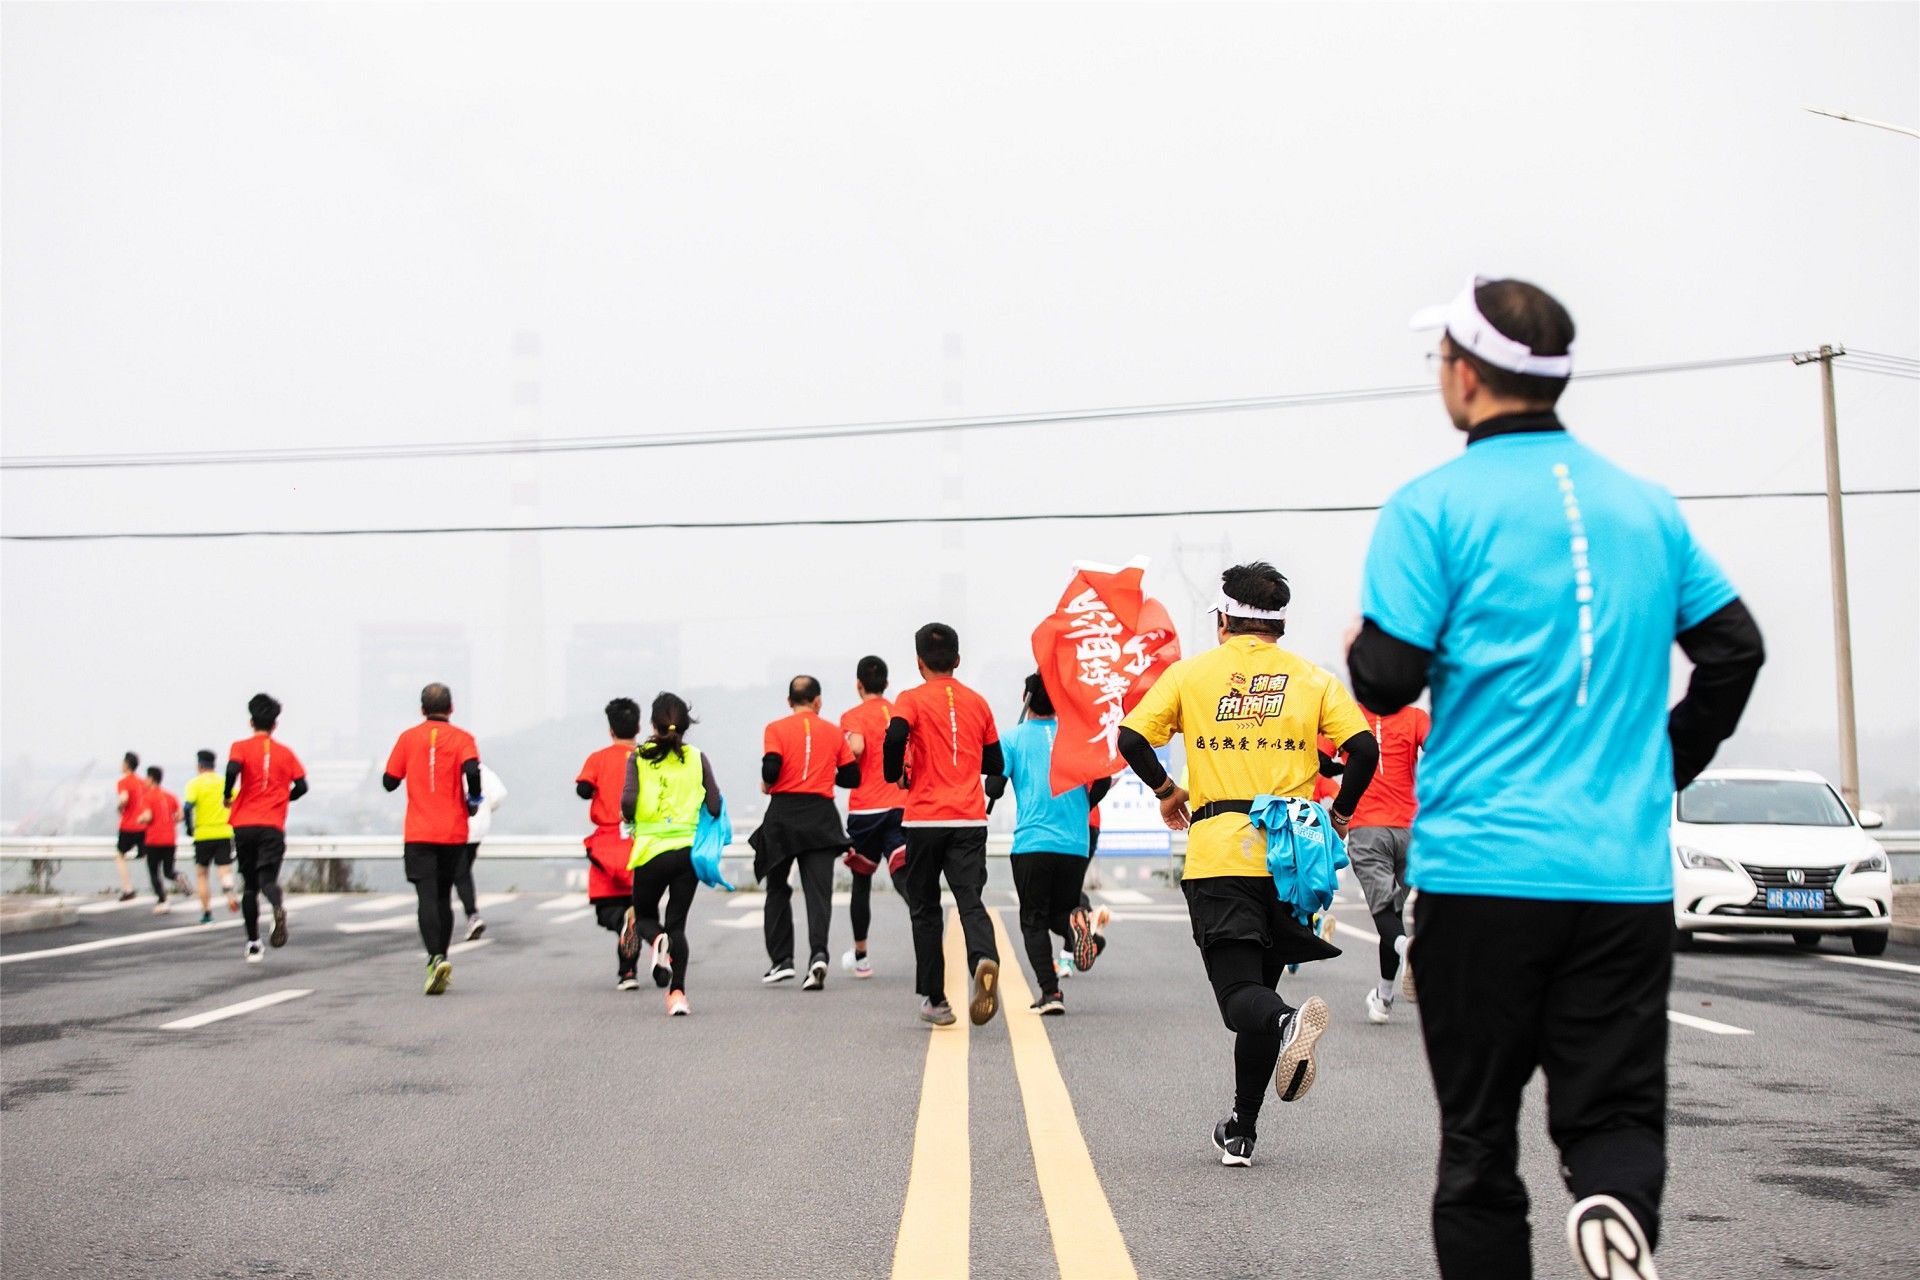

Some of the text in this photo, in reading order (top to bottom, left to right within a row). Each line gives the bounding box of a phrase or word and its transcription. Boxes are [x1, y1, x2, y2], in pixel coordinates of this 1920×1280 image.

[1251, 675, 1287, 693] 湖南
[1217, 694, 1284, 720] 热跑团
[1196, 736, 1249, 751] 因为热爱
